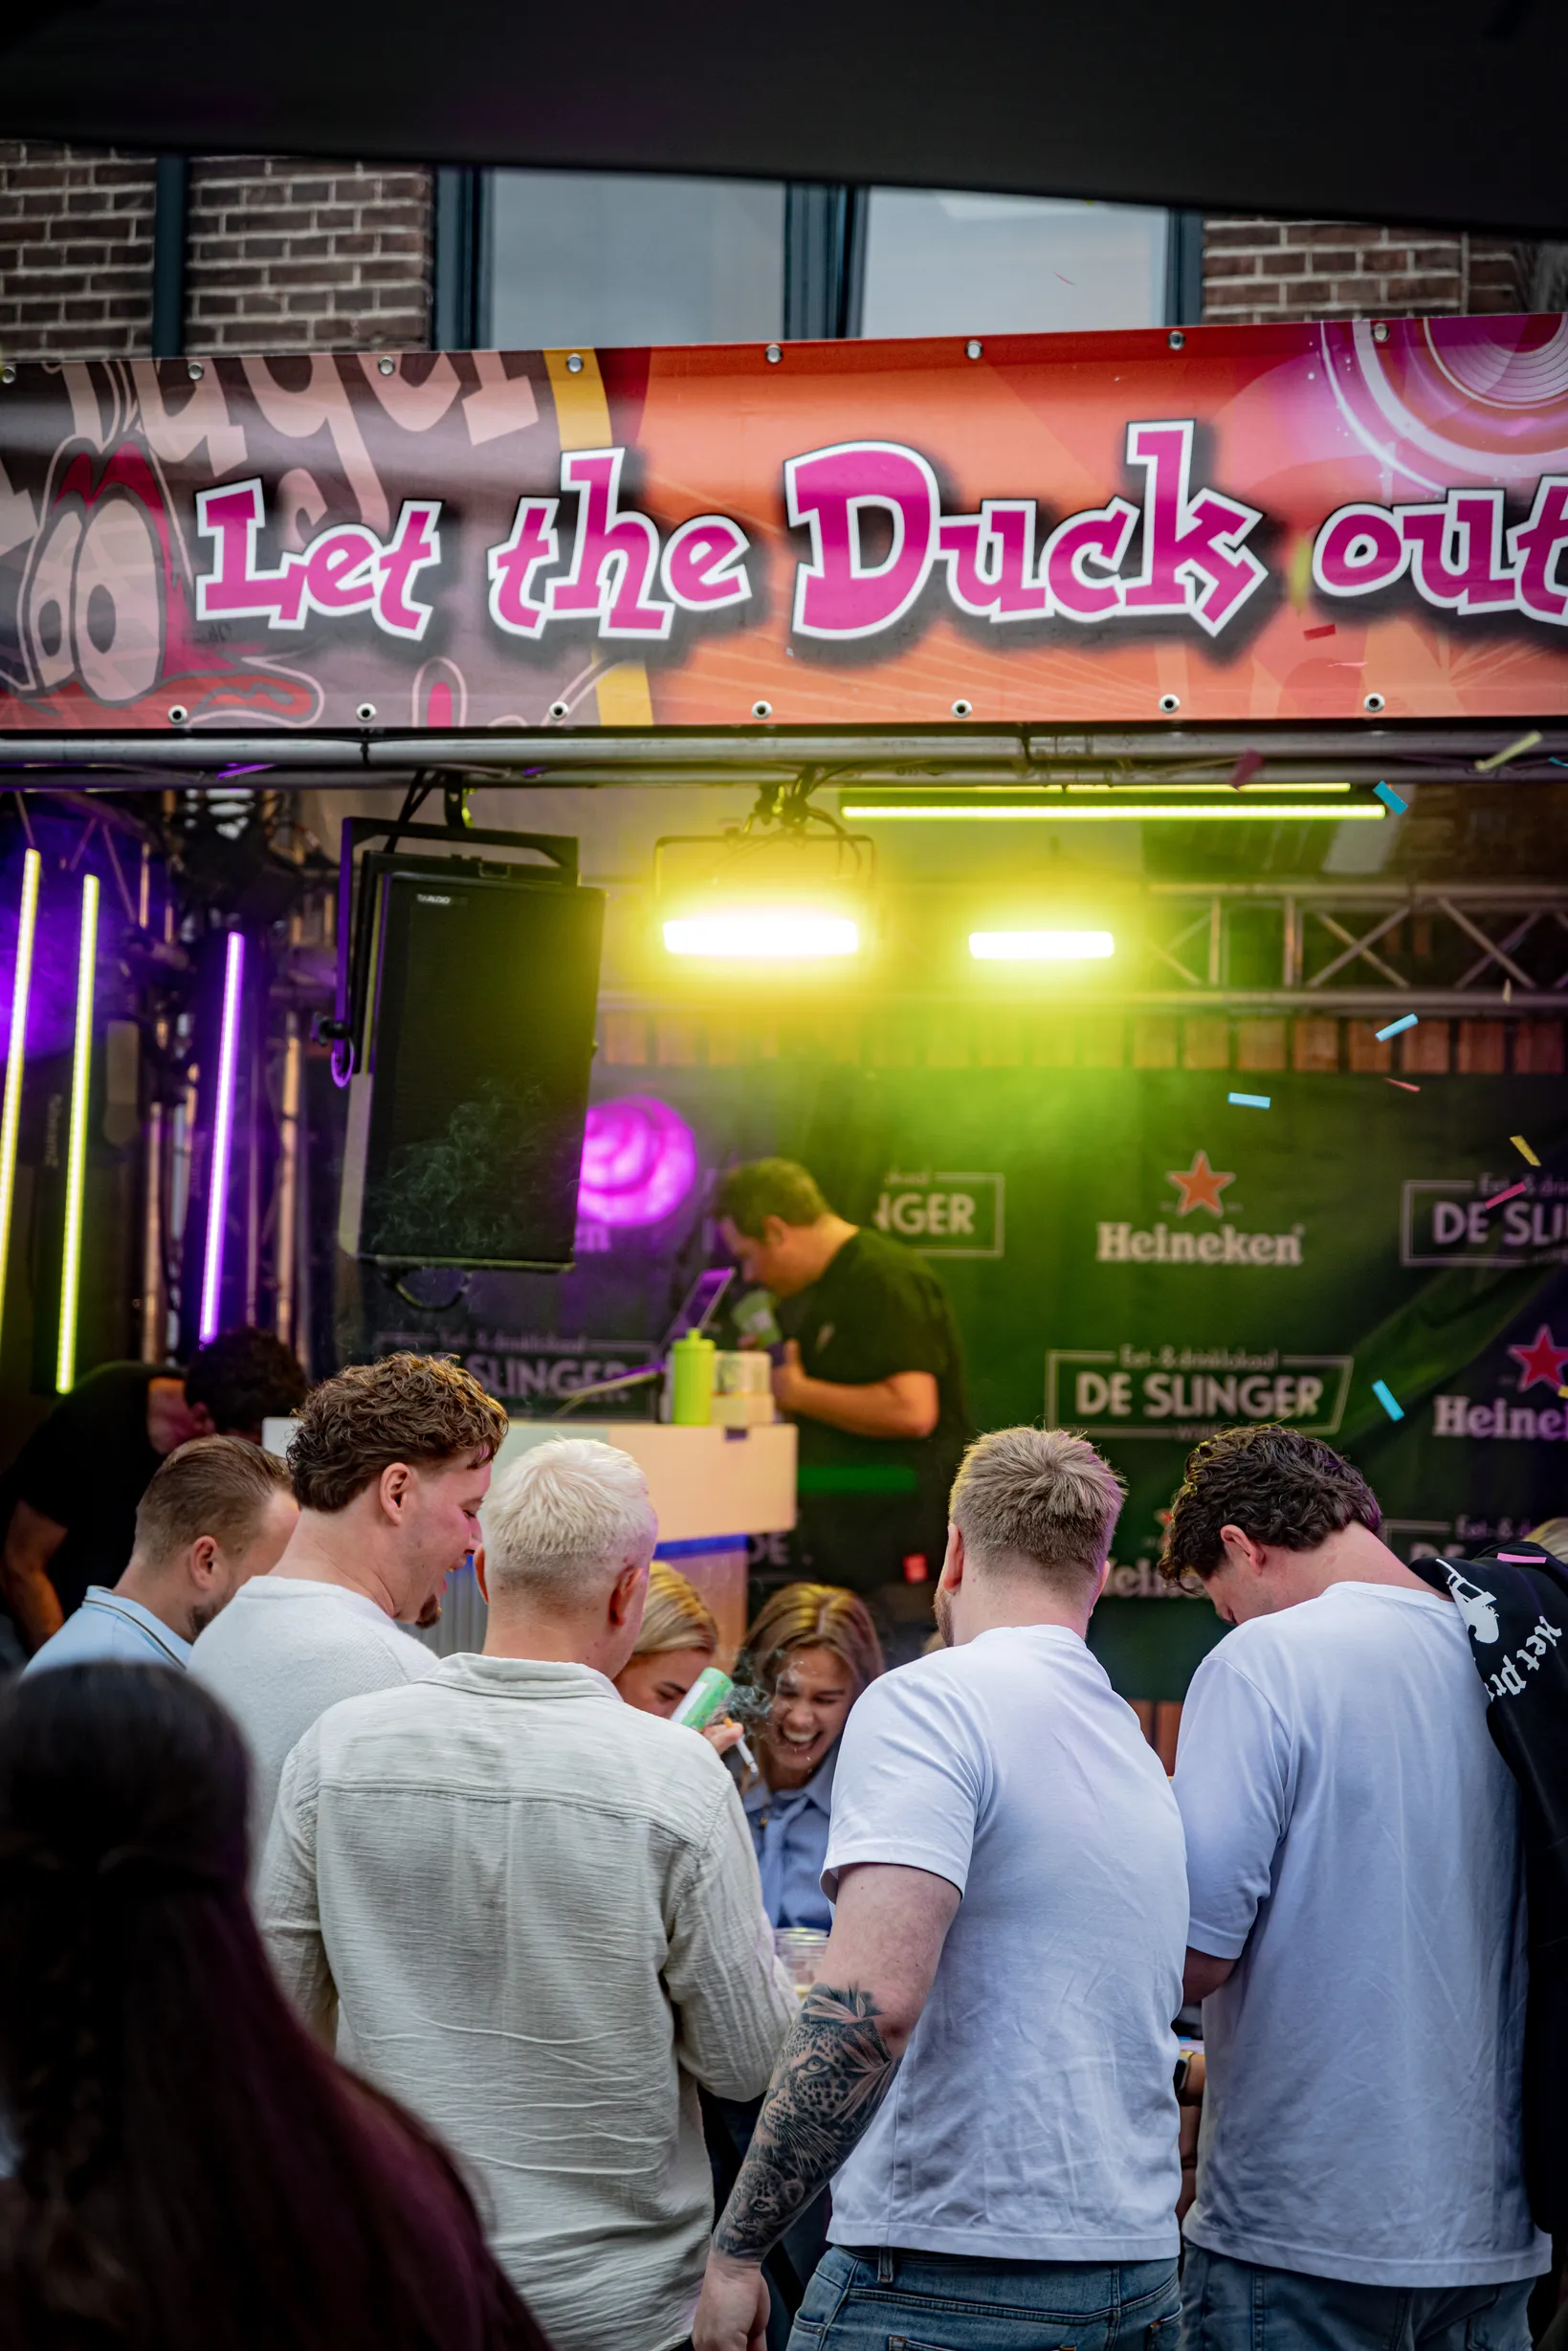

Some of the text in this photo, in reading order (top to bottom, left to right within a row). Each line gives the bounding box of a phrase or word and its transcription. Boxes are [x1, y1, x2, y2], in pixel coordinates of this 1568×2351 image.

[195, 419, 1568, 640] Let the Duck out
[1096, 1221, 1304, 1266] Heineken
[1432, 1200, 1568, 1246] DE SLI
[1074, 1371, 1324, 1418] DE SLINGER
[1432, 1394, 1568, 1442] Heine
